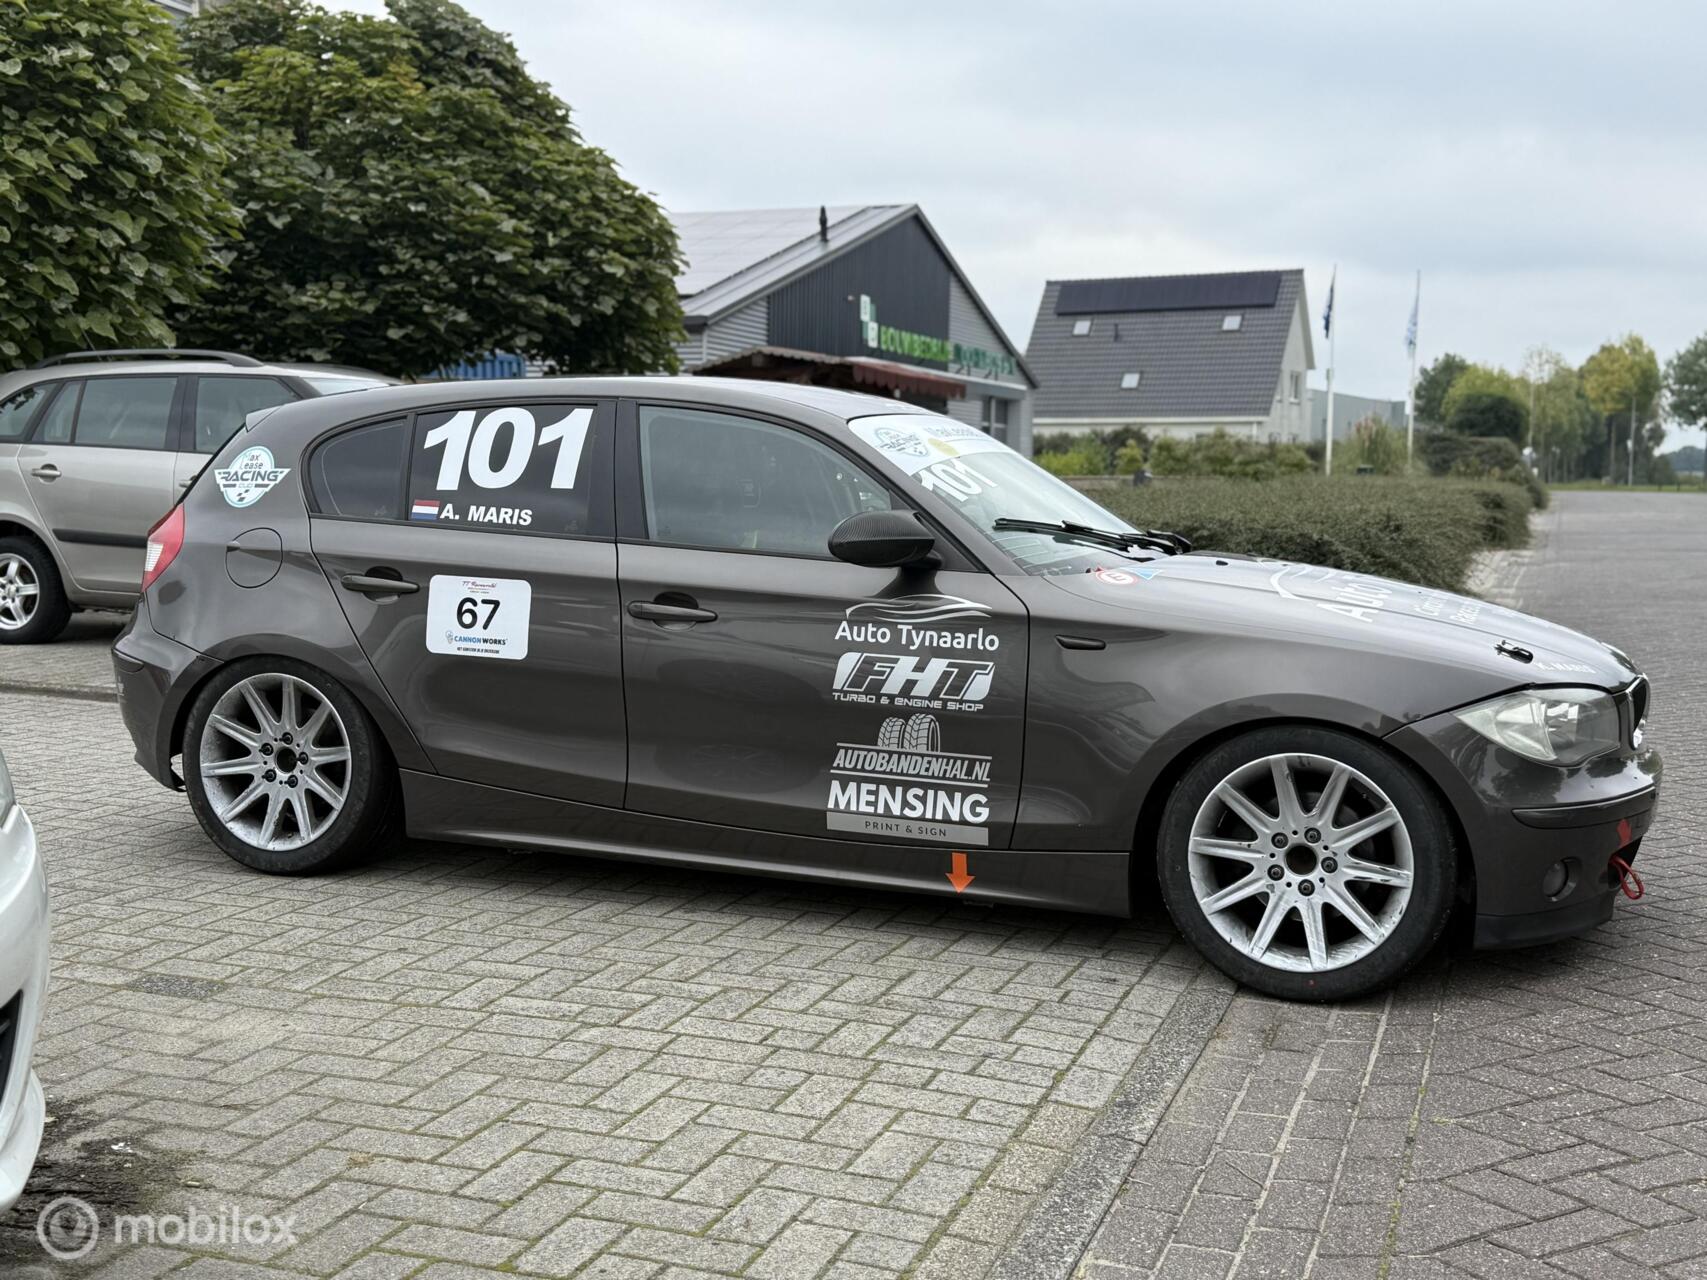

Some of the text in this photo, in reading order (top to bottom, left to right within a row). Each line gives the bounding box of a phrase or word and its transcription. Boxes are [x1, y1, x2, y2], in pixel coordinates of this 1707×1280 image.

[424, 407, 594, 491] 101
[218, 470, 281, 482] RACING
[919, 458, 998, 502] 101
[440, 503, 533, 526] A. MARIS
[456, 597, 500, 630] 67
[834, 620, 1000, 651] Auto Tynaarlo
[840, 652, 995, 701] FHT
[832, 692, 984, 711] TURBO & ENGINE SHOP
[833, 749, 991, 782] AUTOBANDENHAL.NL
[827, 780, 990, 824] MENSING
[865, 820, 947, 837] PRINT & SIGN
